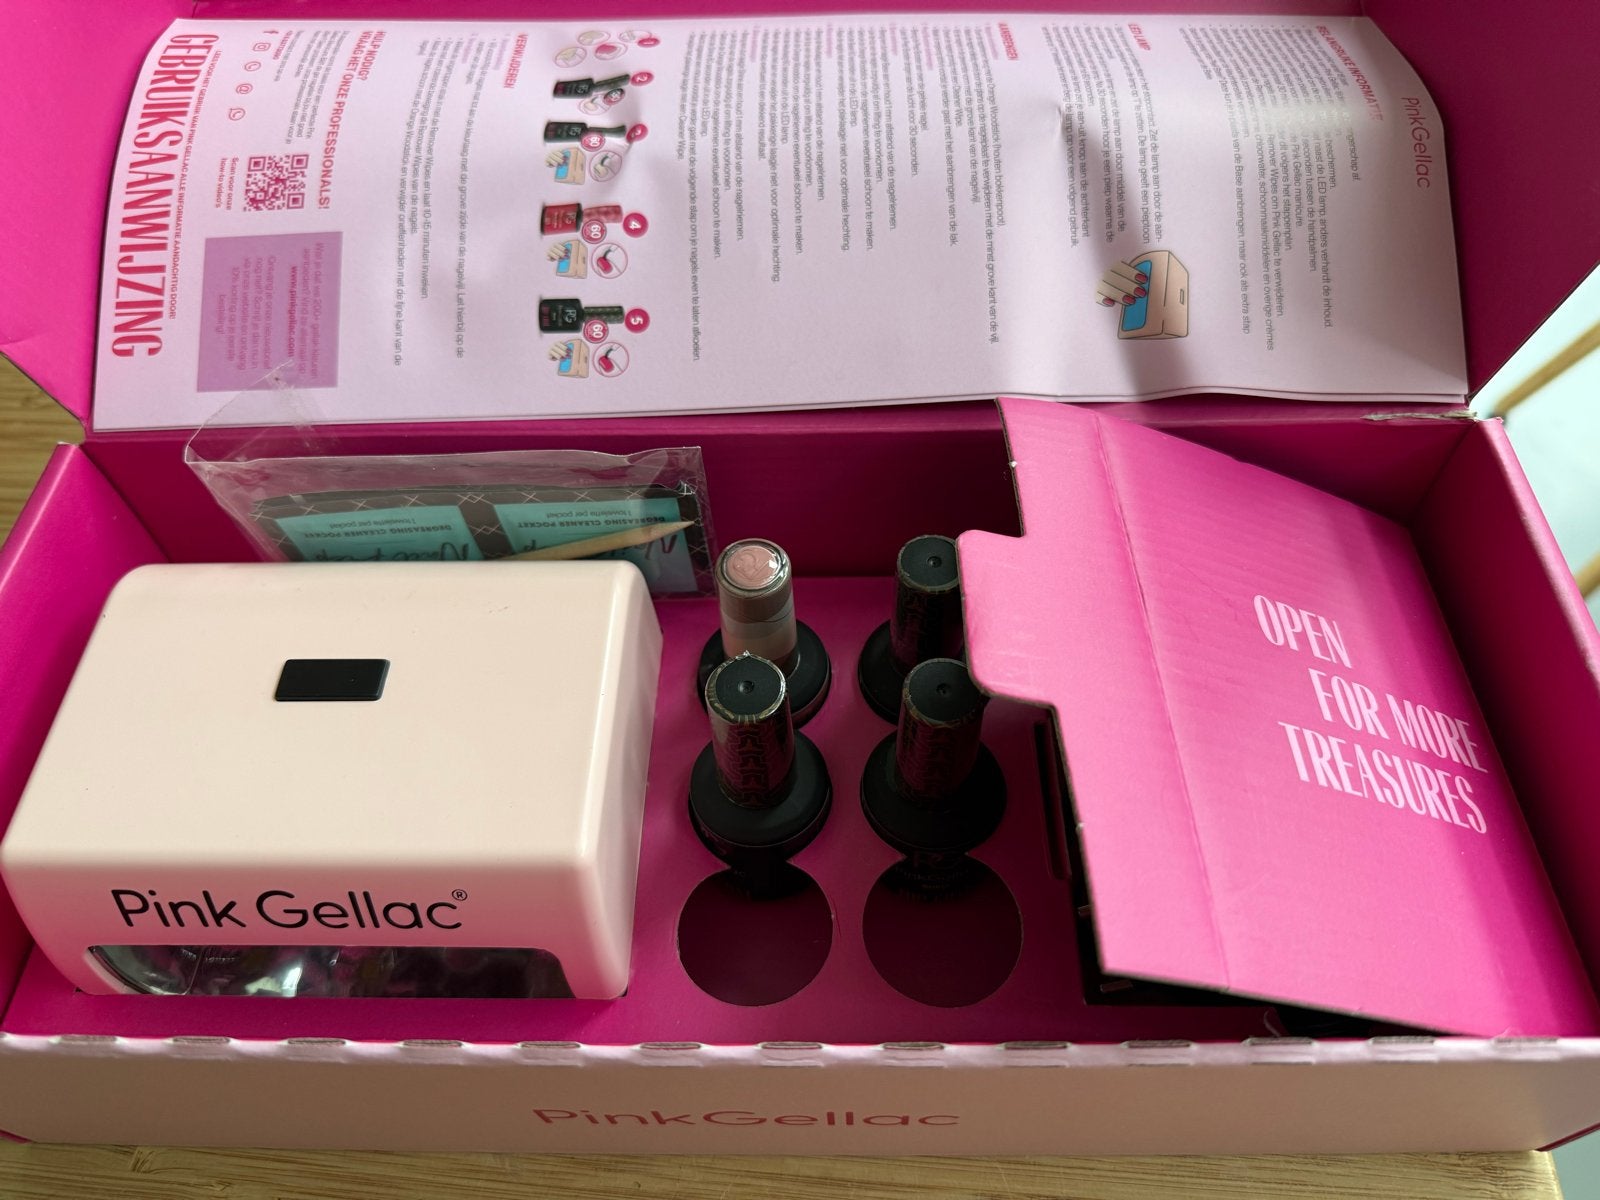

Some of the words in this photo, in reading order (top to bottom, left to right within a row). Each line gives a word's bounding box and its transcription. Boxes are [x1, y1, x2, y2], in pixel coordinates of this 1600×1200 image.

[353, 31, 372, 55] VRAAG
[368, 31, 386, 49] HULP
[1316, 26, 1352, 67] BELANGRIJKE
[210, 51, 221, 62] LEES
[345, 56, 359, 72] HET
[358, 50, 377, 80] NODIG?
[504, 34, 528, 88] VERWIJDEREN
[205, 62, 217, 77] VOOR
[201, 77, 211, 88] HET
[336, 74, 352, 99] ONZE
[193, 89, 206, 115] GEBRUIK
[190, 116, 199, 129] VAN
[186, 129, 195, 146] PINK
[590, 136, 599, 147] 60
[735, 133, 744, 159] afstand
[885, 123, 894, 149] afstand
[1401, 97, 1432, 189] PinkGellac
[181, 146, 192, 173] GELLAC
[318, 102, 346, 209] PROFESSIONALS!
[863, 140, 873, 177] eventueel
[1078, 139, 1088, 160] knop
[1137, 148, 1148, 166] lamp
[218, 158, 227, 182] how-to
[231, 157, 239, 175] Scan
[411, 156, 421, 178] Wipes
[423, 157, 433, 179] Wipes
[711, 148, 720, 186] eventueel
[792, 144, 801, 181] eventueel
[841, 159, 849, 175] voor
[1115, 153, 1124, 172] door
[1150, 155, 1160, 173] lamp
[179, 173, 187, 191] ALLE
[227, 176, 235, 192] voor
[944, 155, 956, 202] aanbrengen
[1137, 168, 1149, 188] geeft
[1235, 166, 1245, 186] Base
[1269, 169, 1279, 194] Wipes
[1292, 162, 1301, 186] Gellac
[111, 34, 220, 357] GEBRUIKSAANWIJZING
[215, 183, 225, 208] video's
[398, 178, 406, 212] verwijder
[688, 168, 698, 204] volgende
[839, 178, 850, 212] optimale
[865, 179, 874, 209] schoon
[982, 168, 992, 211] verwijderen
[1102, 177, 1113, 196] piep
[1115, 173, 1125, 201] middel
[1305, 179, 1314, 204] tussen
[1317, 176, 1326, 194] LED
[225, 193, 234, 210] onze
[423, 194, 431, 207] laat
[459, 186, 467, 209] grove
[712, 188, 721, 218] schoon
[770, 188, 778, 206] voor
[794, 183, 802, 213] schoon
[1068, 184, 1080, 215] volgend
[1142, 190, 1150, 205] een
[1154, 191, 1162, 209] door
[174, 193, 184, 239] INFORMATIE
[459, 211, 468, 229] zijde
[688, 205, 698, 223] stap
[948, 204, 957, 218] van
[1081, 193, 1091, 237] achterkant
[1104, 198, 1114, 228] waarna
[1117, 204, 1125, 218] van
[1272, 212, 1280, 228] Pink
[590, 225, 600, 238] 60
[629, 221, 641, 230] 4
[770, 209, 780, 244] optimale
[1140, 207, 1151, 244] pieptoon
[1258, 182, 1271, 272] schoonmaakmiddelen
[1319, 219, 1328, 247] anders
[397, 214, 406, 270] oneffenheden
[421, 232, 430, 264] minuten
[986, 241, 996, 262] minst
[1238, 240, 1247, 261] maar
[1272, 231, 1282, 256] Gellac
[170, 240, 181, 292] AANDACHTIG
[689, 248, 699, 274] nagels
[1239, 262, 1249, 278] ook
[1321, 249, 1331, 283] verhardt
[396, 272, 404, 287] met
[691, 276, 699, 294] even
[986, 264, 996, 286] grove
[988, 287, 997, 304] kant
[1240, 280, 1249, 292] als
[169, 294, 177, 320] DOOR!
[394, 302, 403, 318] fijne
[1241, 294, 1250, 314] extra
[1262, 286, 1273, 317] overige
[455, 307, 465, 332] hierbij
[630, 316, 643, 325] 5
[692, 306, 700, 325] laten
[989, 306, 998, 320] van
[395, 320, 403, 336] kant
[592, 324, 602, 338] 60
[1240, 316, 1251, 335] stap
[358, 518, 372, 527] per
[546, 511, 573, 520] pocket
[558, 519, 602, 527] CLEANER
[574, 510, 588, 519] per
[589, 509, 627, 518] towelette
[604, 516, 665, 525] DEGREASING
[329, 520, 357, 529] pocket
[344, 528, 387, 538] CLEANER
[389, 524, 451, 534] DEGREASING
[1253, 594, 1352, 669] OPEN
[1308, 667, 1391, 740] FOR
[1386, 692, 1488, 773] MORE
[1278, 720, 1487, 834] TREASURES
[111, 888, 247, 929] Pink
[532, 1108, 959, 1126] PinkGellac
